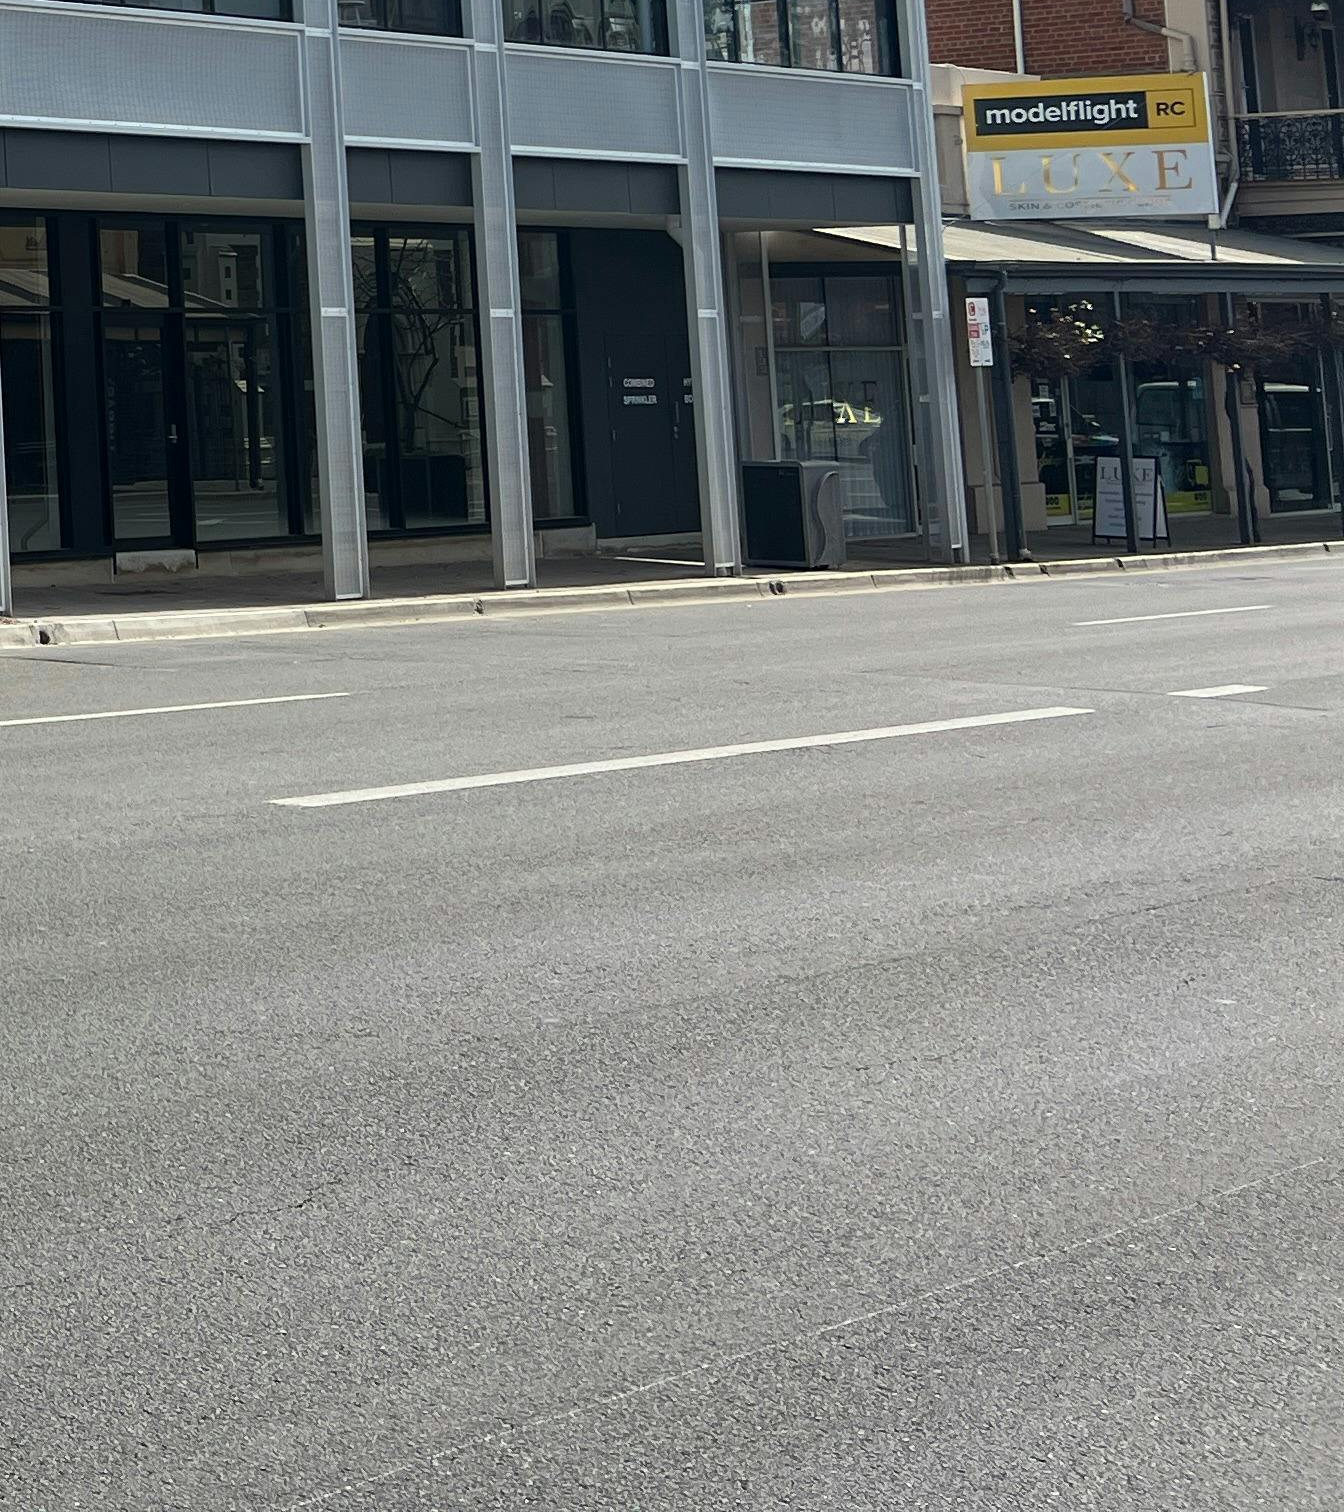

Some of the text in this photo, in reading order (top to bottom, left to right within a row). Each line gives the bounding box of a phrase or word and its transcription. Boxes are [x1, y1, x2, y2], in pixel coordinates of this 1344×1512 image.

[985, 98, 1186, 125] modelflight RC
[990, 149, 1193, 196] LUXE
[1009, 201, 1040, 211] SKIN
